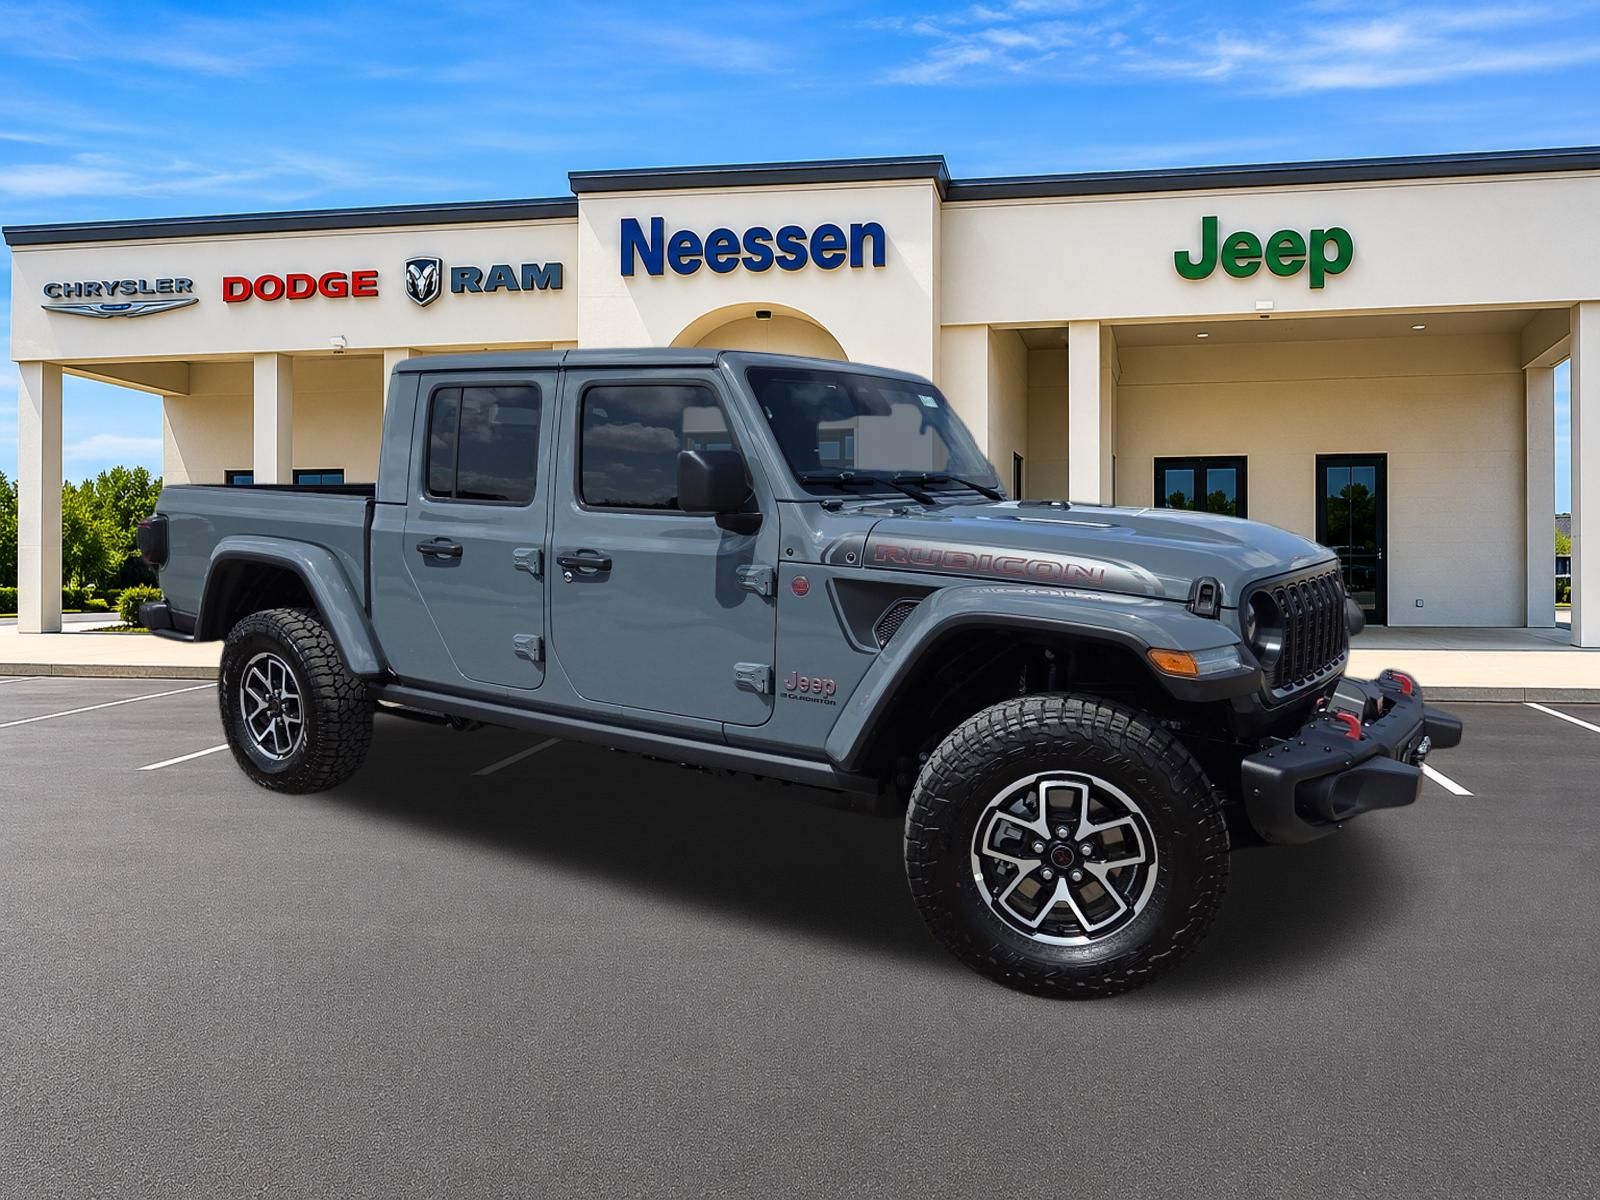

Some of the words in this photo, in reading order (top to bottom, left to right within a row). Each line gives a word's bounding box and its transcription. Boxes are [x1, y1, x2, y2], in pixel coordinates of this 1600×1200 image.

[620, 217, 886, 276] Neessen
[1174, 216, 1354, 288] Jeep
[43, 278, 193, 299] CHRYSLER
[223, 270, 378, 303] DODGE
[450, 262, 563, 294] RAM
[874, 544, 1105, 584] RUBICON
[783, 671, 836, 699] Jeep
[788, 693, 836, 705] GLADIATOR
